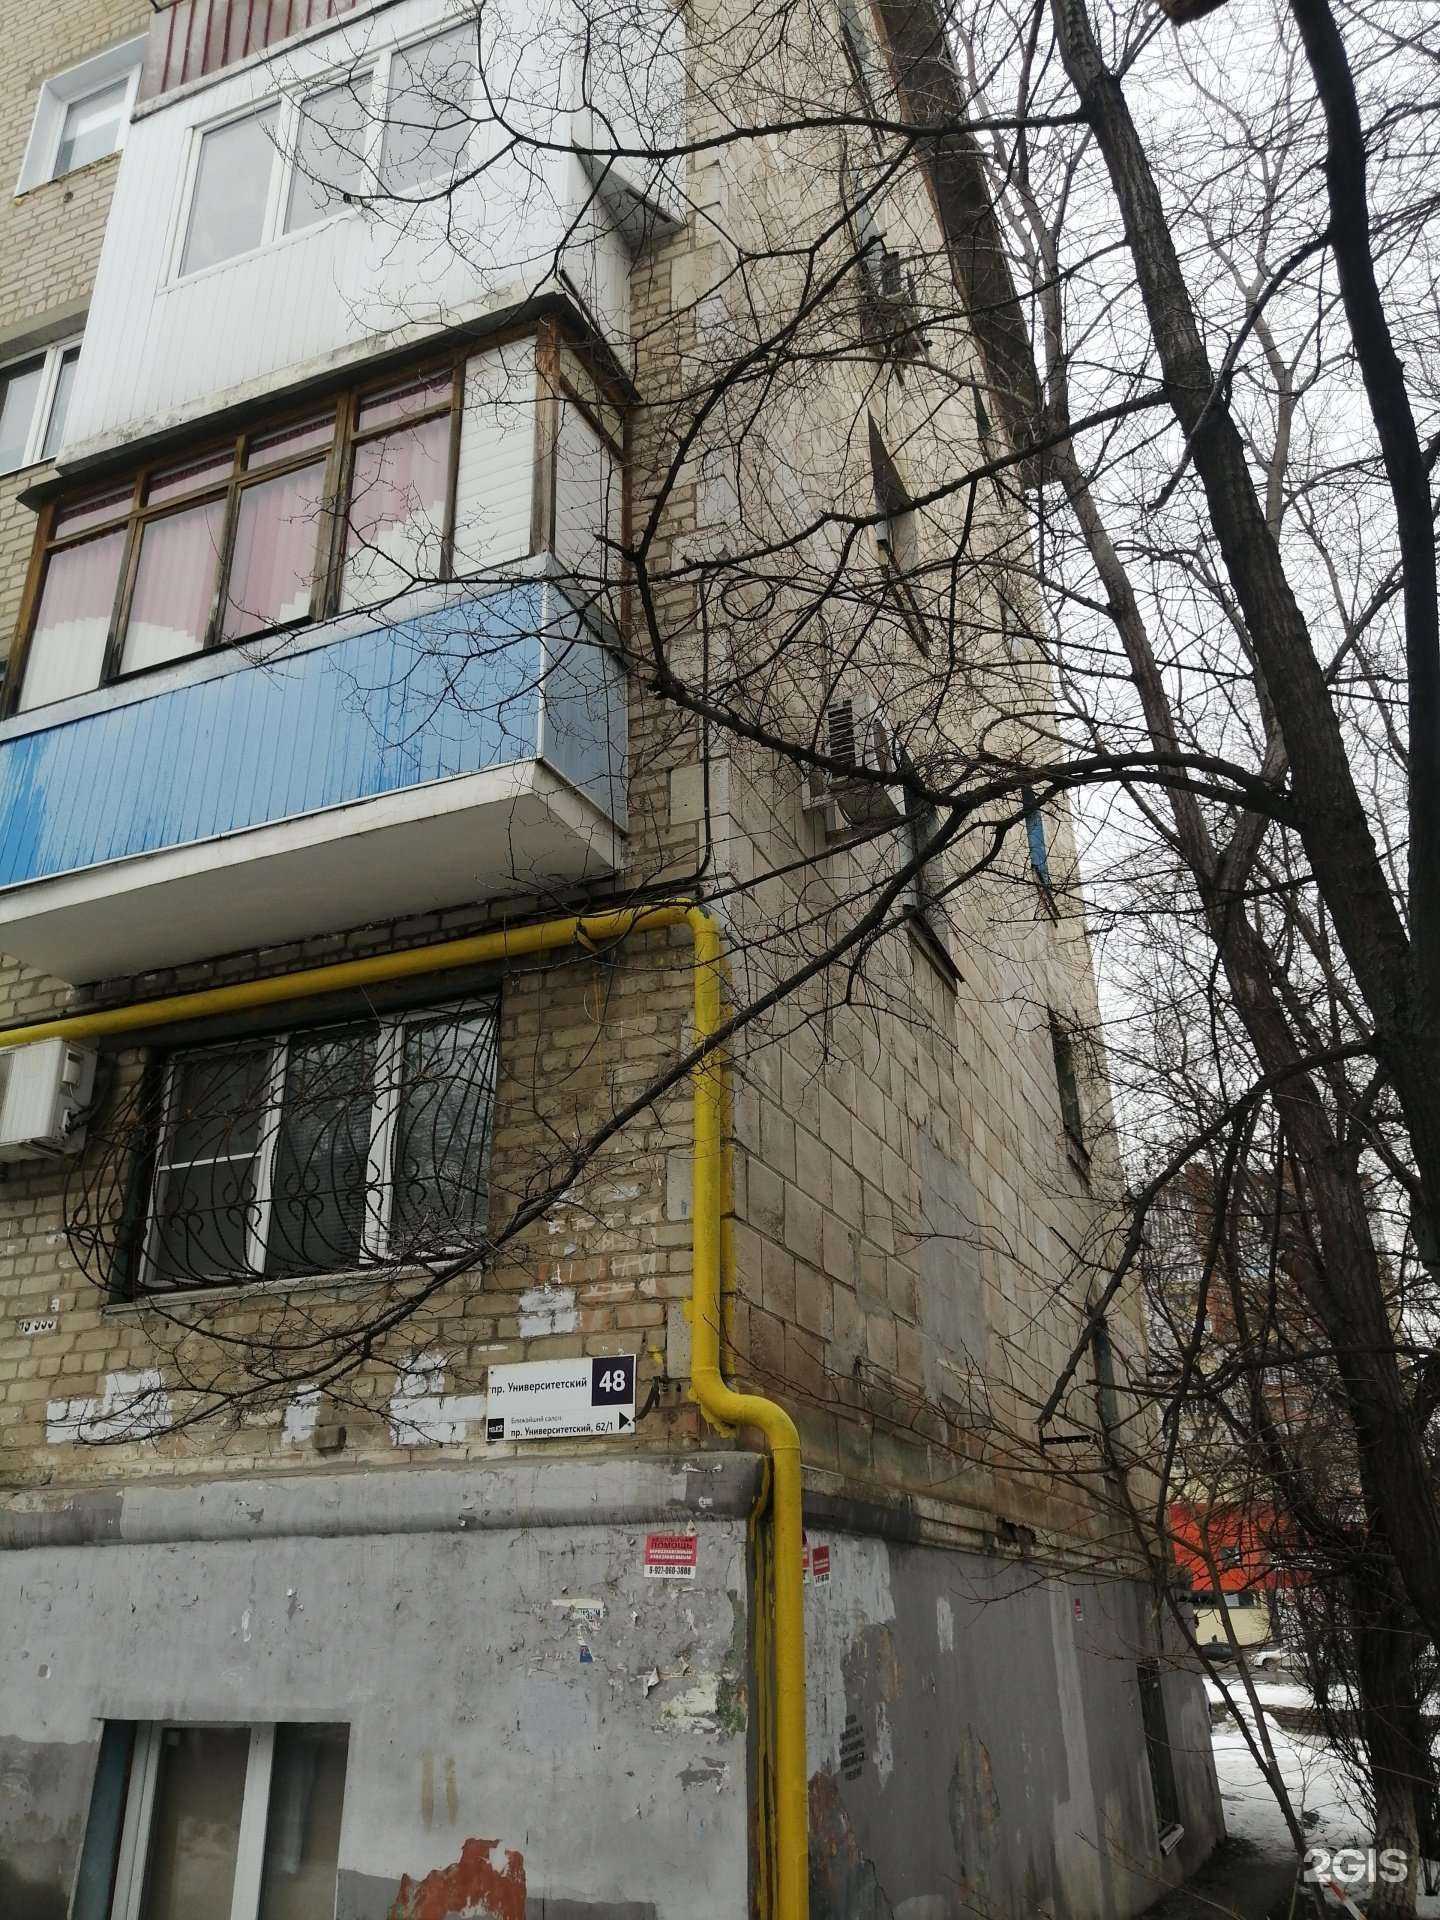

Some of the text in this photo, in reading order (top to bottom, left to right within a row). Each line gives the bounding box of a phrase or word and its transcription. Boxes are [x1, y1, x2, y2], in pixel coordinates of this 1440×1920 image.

[491, 1370, 626, 1396] пр. Университетский 48
[510, 1422, 614, 1439] пр. Университетский, 62/1
[651, 1542, 692, 1550] ПОМОЩЬ
